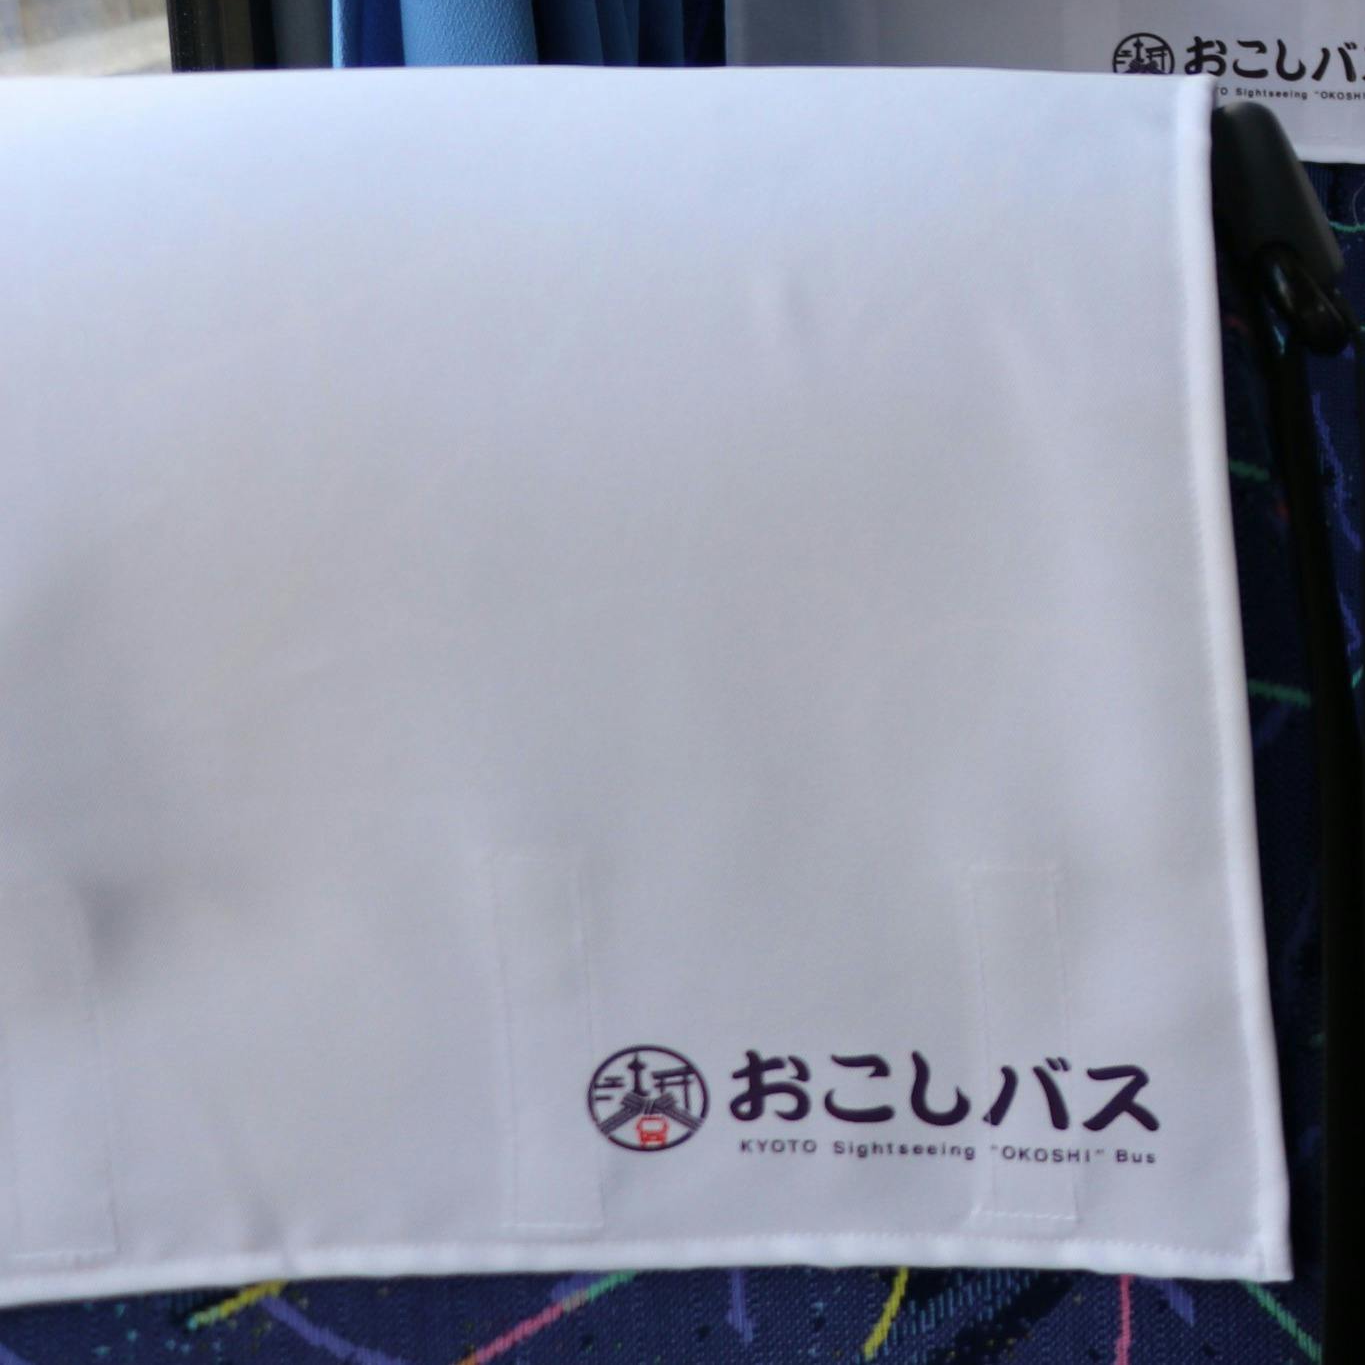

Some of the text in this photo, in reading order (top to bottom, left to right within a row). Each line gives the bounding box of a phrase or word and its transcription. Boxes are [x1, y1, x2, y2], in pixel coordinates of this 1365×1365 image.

[729, 1049, 1160, 1132] おこしバス
[739, 1138, 818, 1154] KYOTO
[833, 1140, 976, 1161] Sightseeing
[1114, 1148, 1157, 1165] Bus
